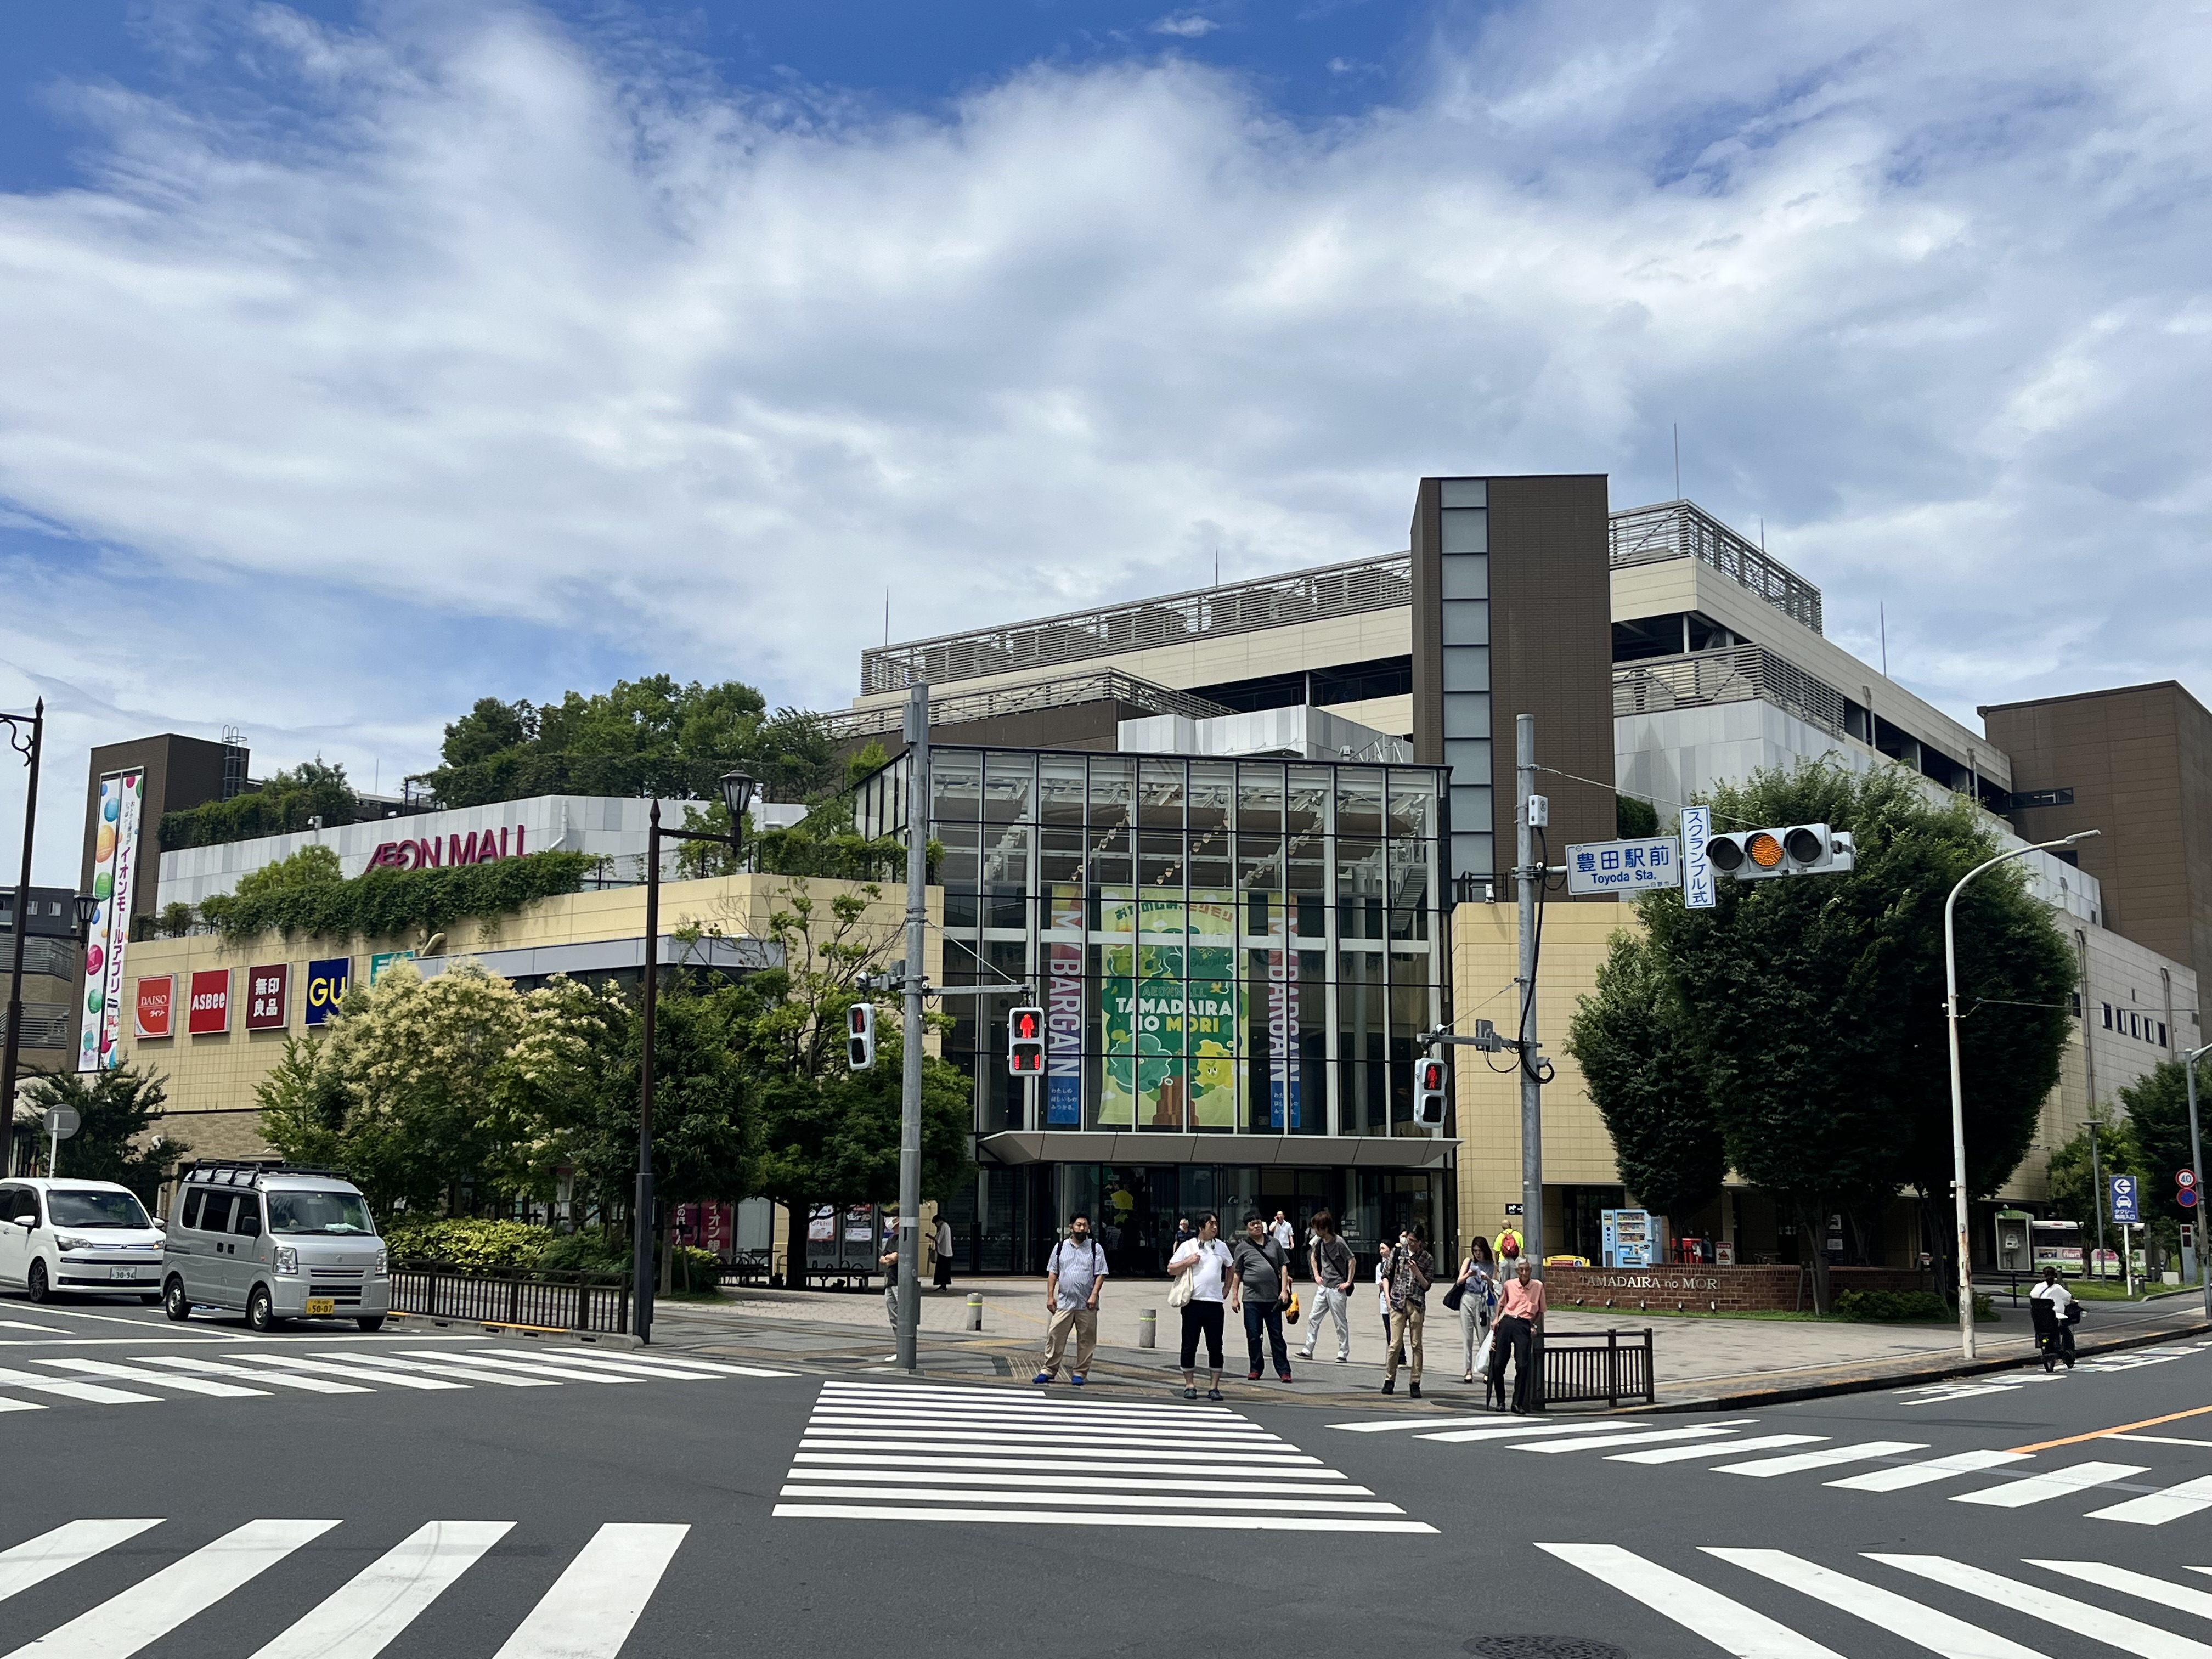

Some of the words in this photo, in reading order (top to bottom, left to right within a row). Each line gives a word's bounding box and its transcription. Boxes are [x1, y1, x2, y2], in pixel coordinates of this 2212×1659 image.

[1577, 845, 1669, 873] 豊田駅前
[1688, 811, 1707, 904] スクランブル式
[1591, 871, 1630, 885] Toyoda
[1635, 869, 1657, 881] Sta.
[111, 847, 131, 993] イオンモールアプリ
[255, 977, 280, 995] 無印
[309, 977, 346, 1006] GU
[1142, 986, 1206, 997] AEONMLL
[141, 995, 167, 1006] DAISO
[253, 998, 278, 1017] 良品
[1116, 997, 1233, 1016] TAMADAIRA
[1048, 959, 1081, 1077] BARGAIN
[1166, 1016, 1219, 1032] MORI
[2180, 1175, 2192, 1183] 40
[1579, 1275, 1661, 1288] TAMADAIRA
[1664, 1279, 1678, 1288] no
[1683, 1277, 1722, 1289] MORI
